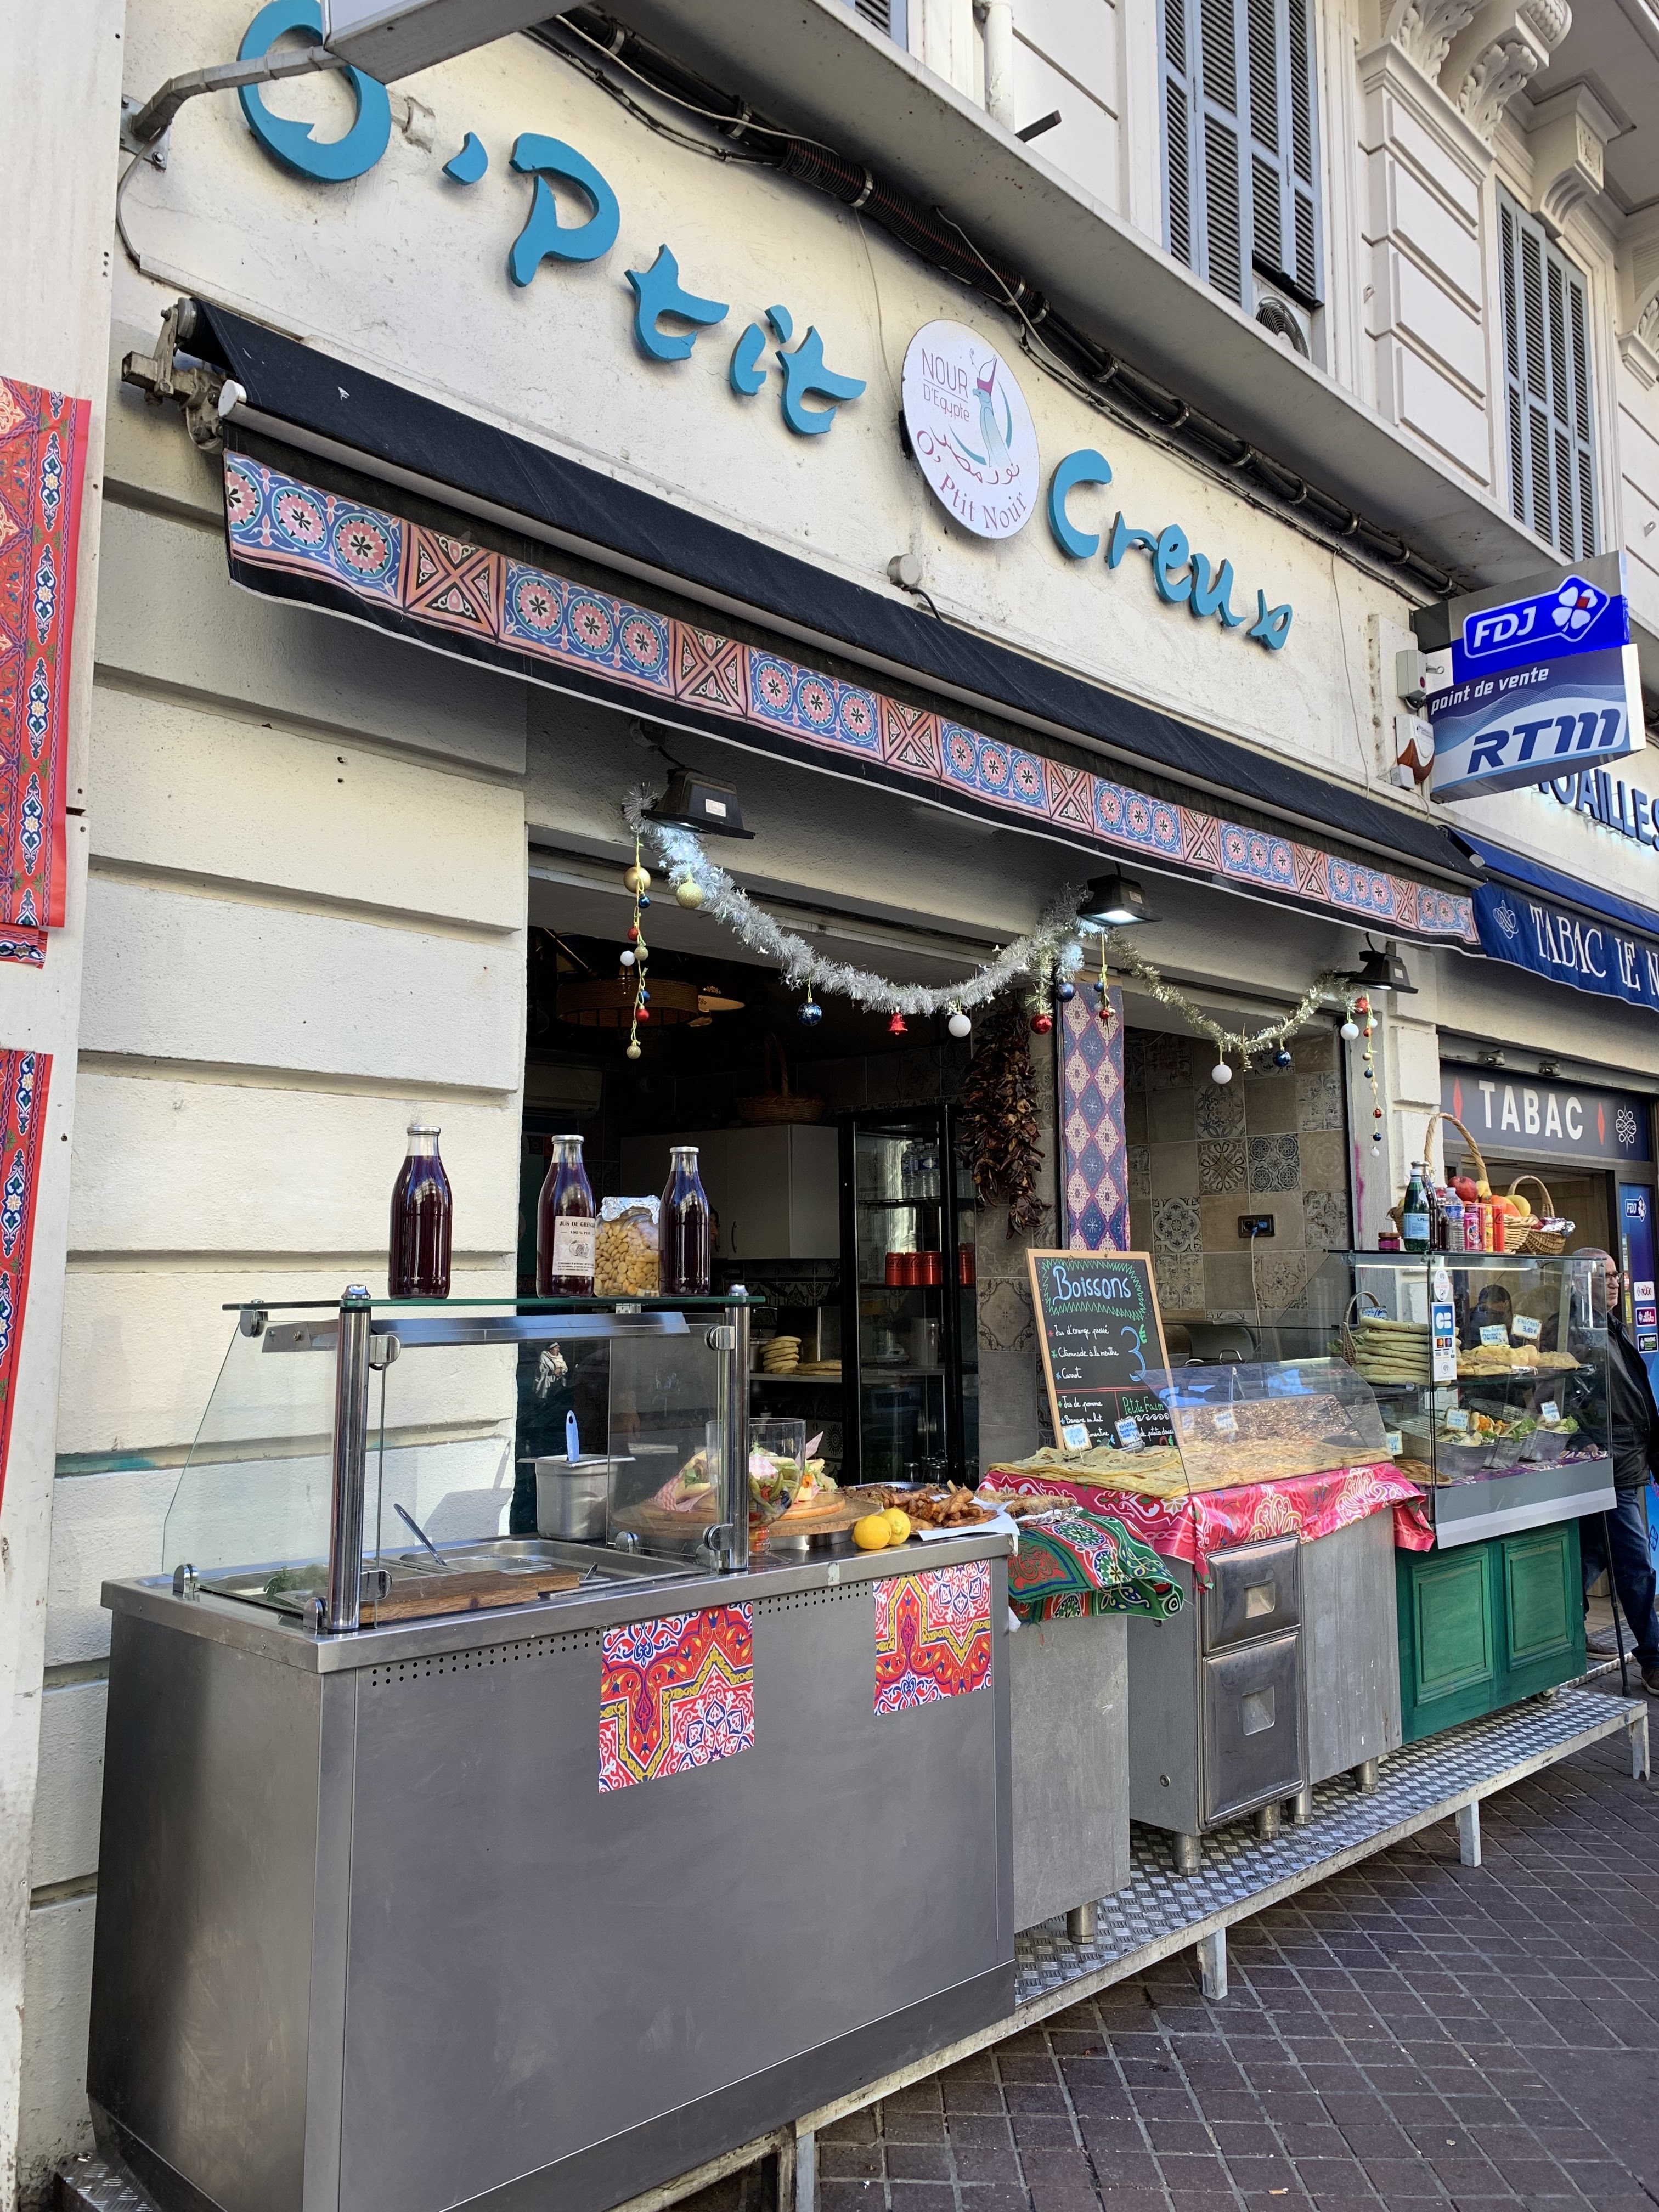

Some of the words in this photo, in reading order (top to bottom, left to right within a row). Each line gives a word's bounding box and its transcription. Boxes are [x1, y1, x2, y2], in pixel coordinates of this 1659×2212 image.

[922, 348, 968, 398] NOUR
[983, 492, 1028, 531] Nour
[1048, 449, 1292, 650] Creux
[1473, 606, 1536, 648] FDJ
[1431, 685, 1471, 715] point
[1474, 680, 1493, 698] de
[1499, 667, 1549, 691] vente
[1529, 902, 1606, 978] TABAC
[1615, 937, 1641, 991] LE
[1479, 1080, 1583, 1141] TABAC
[1627, 1203, 1637, 1214] FDJ
[1053, 1265, 1132, 1306] Boissons
[1054, 1324, 1064, 1336] Jus
[1066, 1324, 1091, 1340] d'orange
[1100, 1346, 1119, 1357] menthe
[1062, 1366, 1082, 1379] Carrot
[1062, 1396, 1072, 1409] Jus
[1073, 1396, 1081, 1408] de
[1082, 1401, 1103, 1412] pomme
[1122, 1397, 1144, 1415] Petite
[1143, 1396, 1165, 1413] Faim
[1064, 1415, 1085, 1424] Banane
[1139, 1427, 1147, 1437] de
